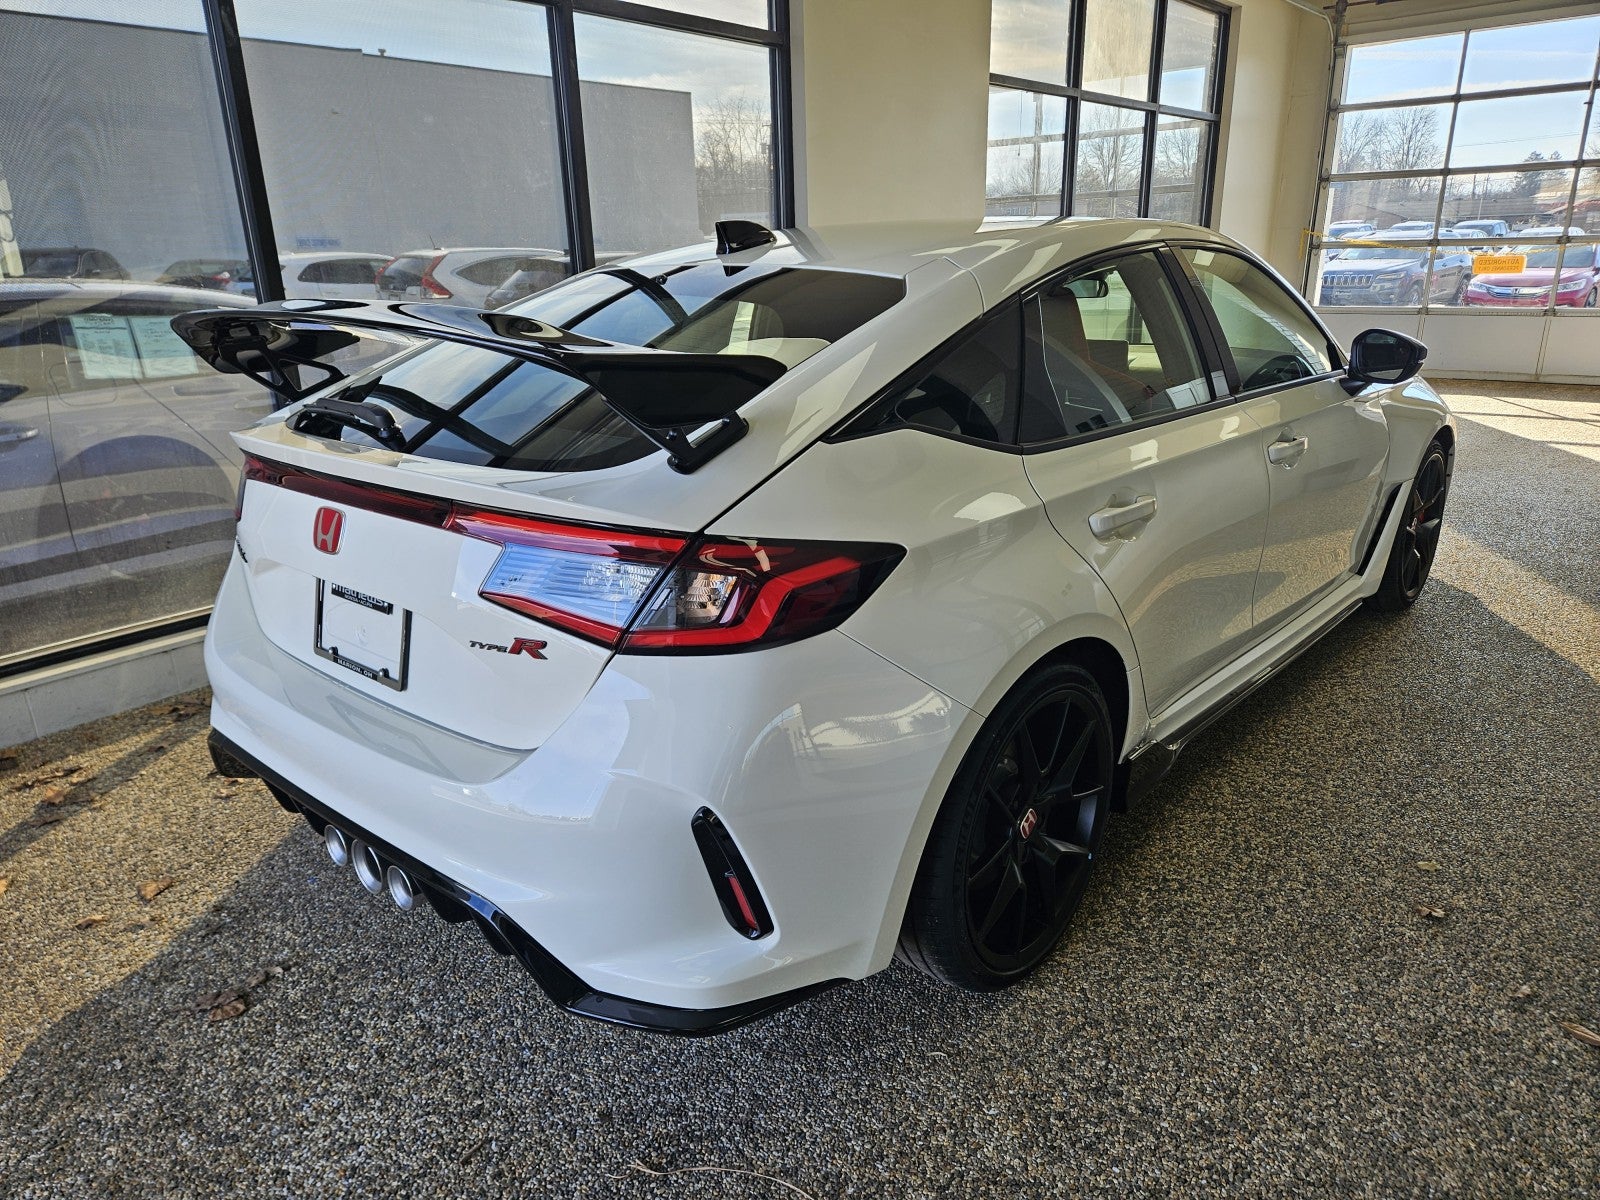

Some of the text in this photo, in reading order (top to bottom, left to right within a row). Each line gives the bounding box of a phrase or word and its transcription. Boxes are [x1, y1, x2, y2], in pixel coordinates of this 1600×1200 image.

[469, 637, 548, 660] TYPE R
[363, 670, 373, 678] OH
